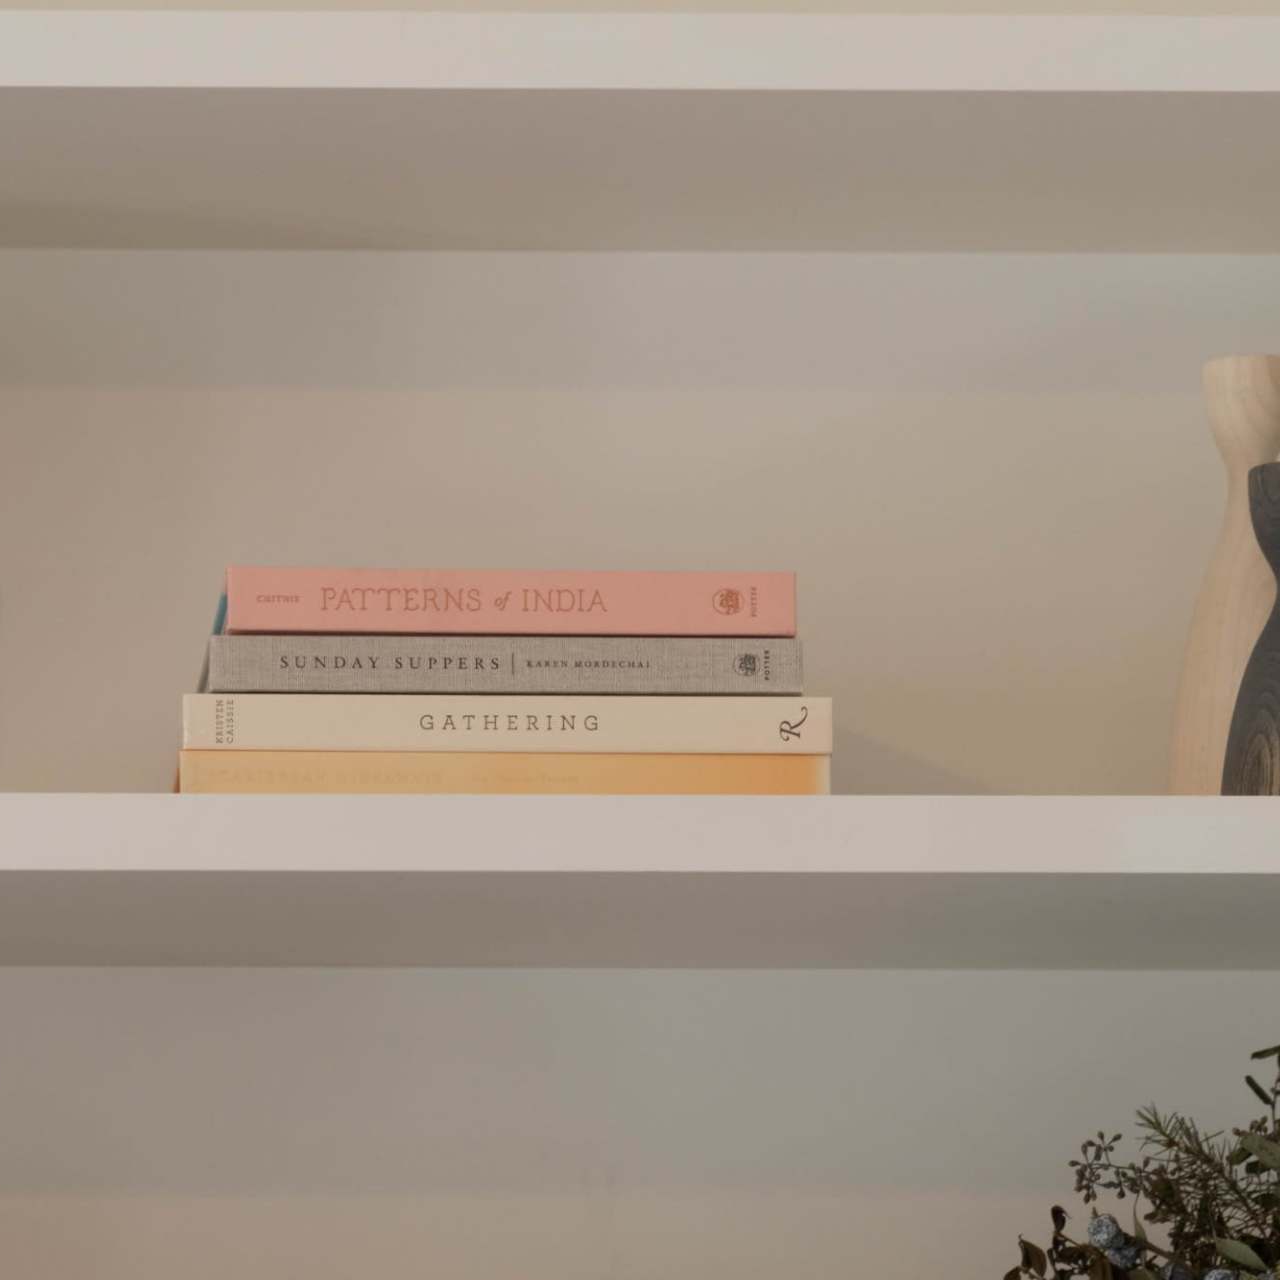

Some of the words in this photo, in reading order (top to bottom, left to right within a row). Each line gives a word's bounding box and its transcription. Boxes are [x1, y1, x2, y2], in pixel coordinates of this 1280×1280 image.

[320, 587, 483, 612] PATTERNS
[494, 591, 513, 610] of
[521, 588, 608, 612] INDIA
[280, 655, 380, 670] SUNDAY
[395, 656, 501, 671] SUPPERS
[526, 660, 568, 669] KAREN
[574, 660, 650, 669] MORDECHAI
[419, 714, 599, 732] GATHERING
